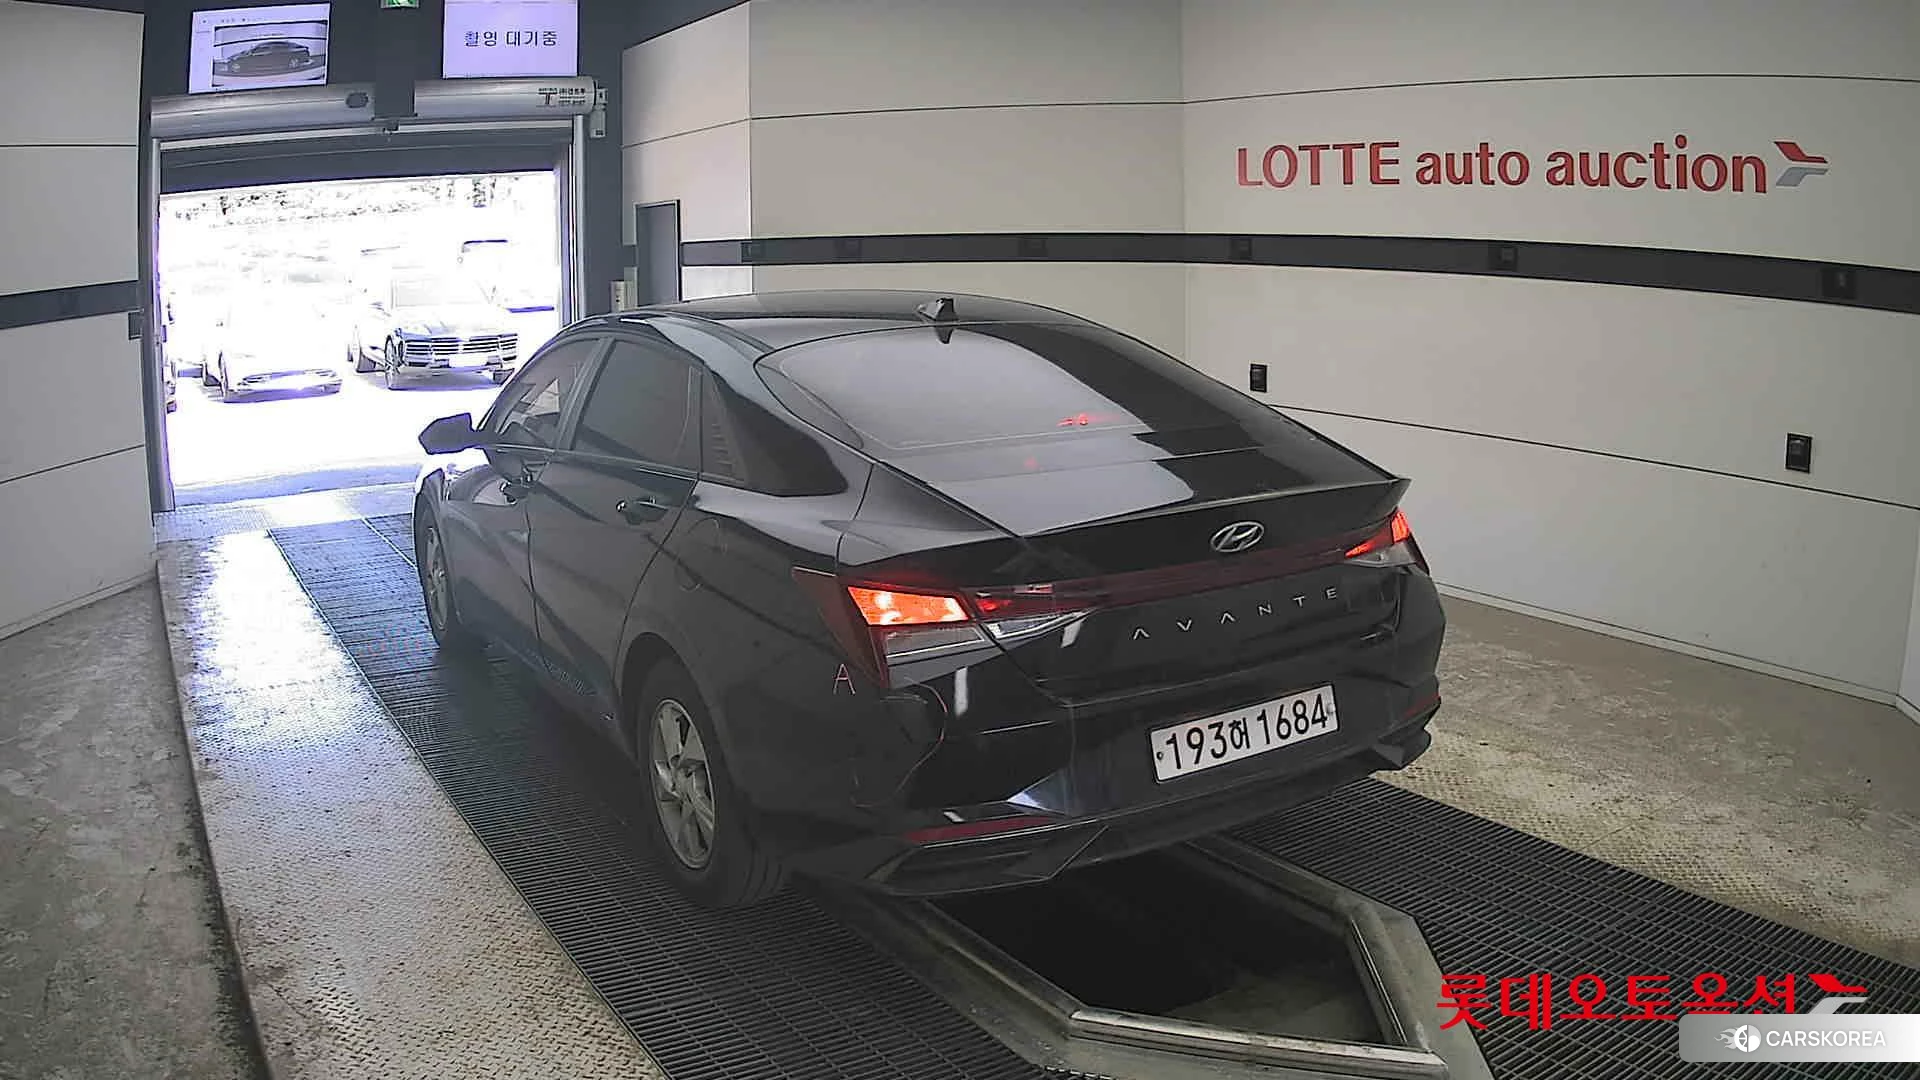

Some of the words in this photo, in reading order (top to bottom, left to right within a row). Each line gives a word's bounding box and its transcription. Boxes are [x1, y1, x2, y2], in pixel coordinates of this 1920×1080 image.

[506, 30, 557, 47] 대기중
[1237, 141, 1400, 188] LOTTE
[1415, 142, 1530, 186] auto
[1546, 134, 1767, 194] auction
[1133, 587, 1337, 640] AVANTE
[832, 663, 856, 695] A
[1166, 717, 1250, 770] 193허
[1257, 693, 1328, 745] 1684
